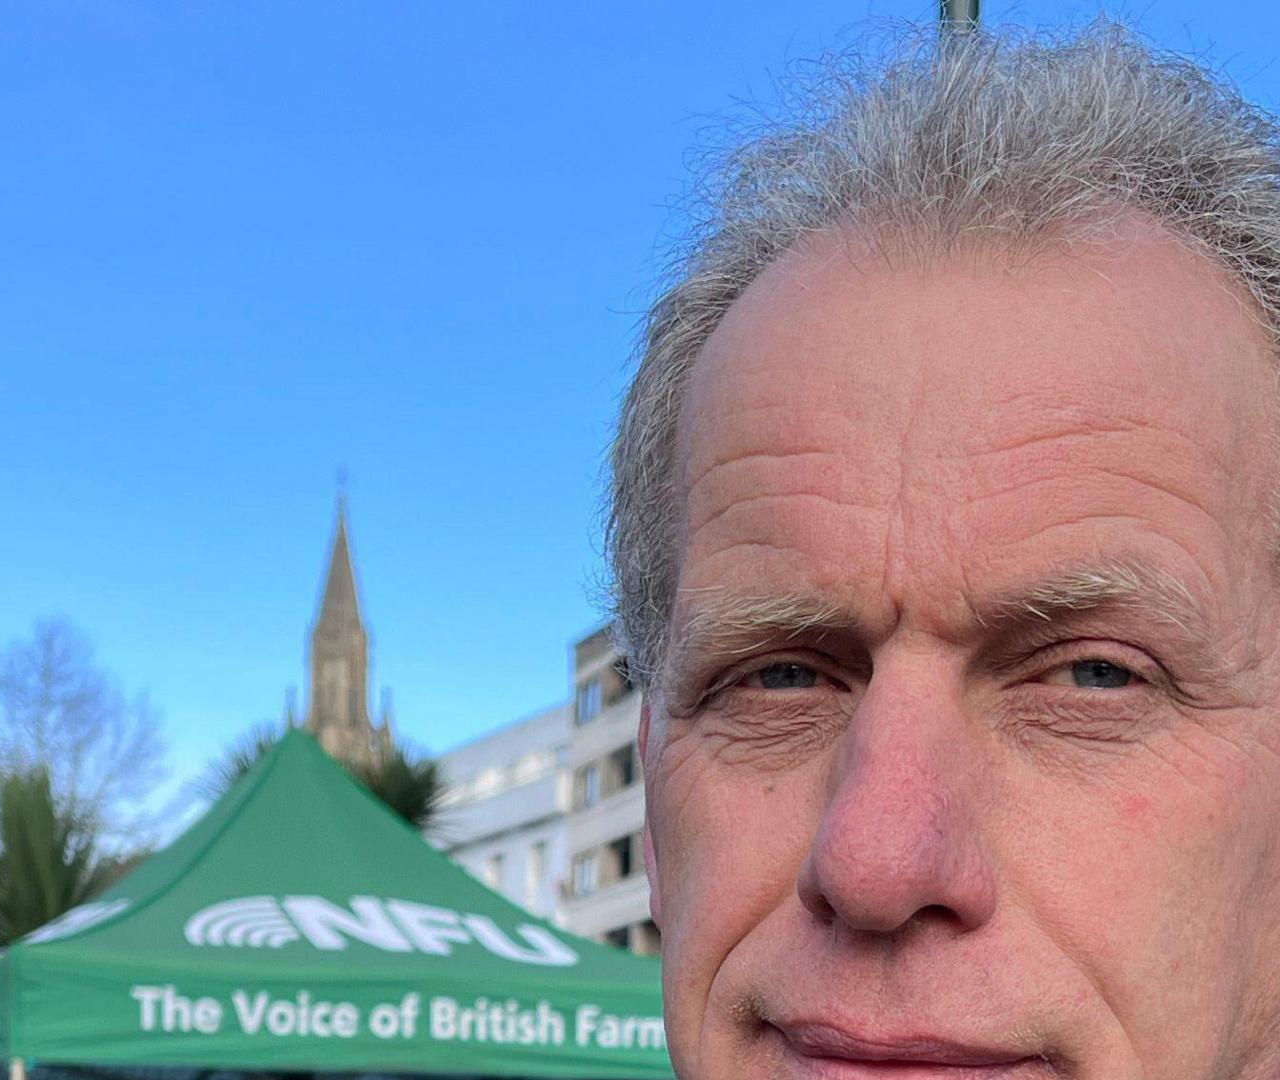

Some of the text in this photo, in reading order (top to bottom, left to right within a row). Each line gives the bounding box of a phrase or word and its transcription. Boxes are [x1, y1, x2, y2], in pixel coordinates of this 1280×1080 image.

[283, 894, 578, 966] NFU
[132, 984, 666, 1050] The Voice of British Farm
